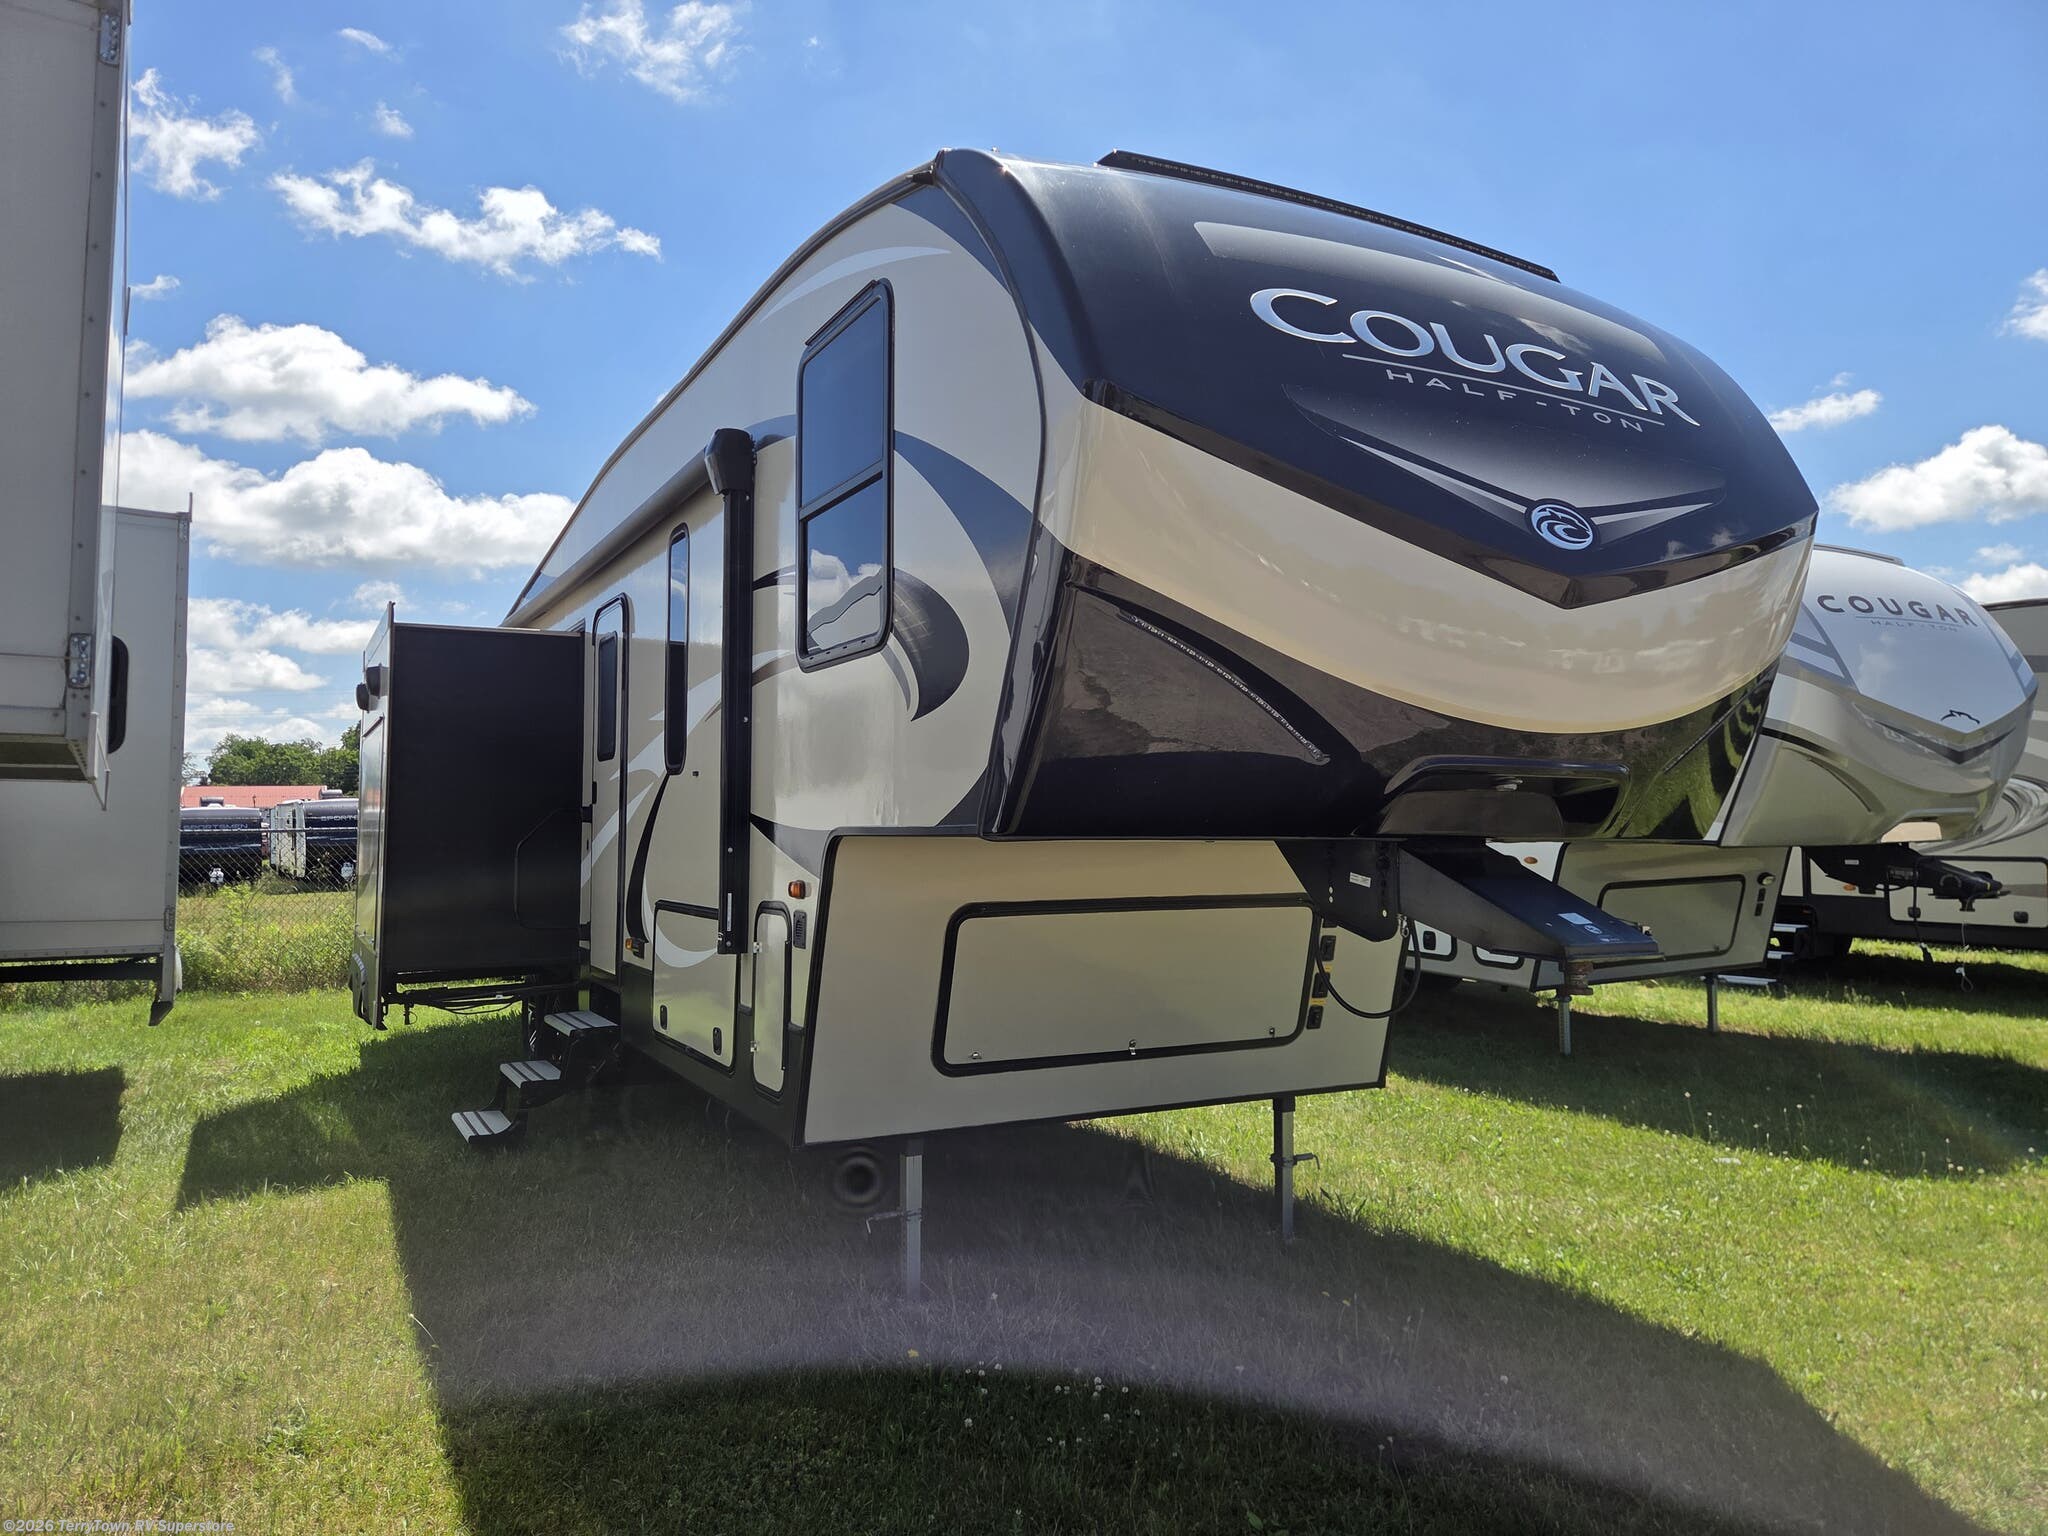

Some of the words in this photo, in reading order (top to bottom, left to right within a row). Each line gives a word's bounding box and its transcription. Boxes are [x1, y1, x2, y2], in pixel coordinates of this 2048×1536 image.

[1249, 287, 1701, 427] COUGAR
[1386, 368, 1644, 433] HALF-TON
[1816, 595, 1978, 627] COUGAR
